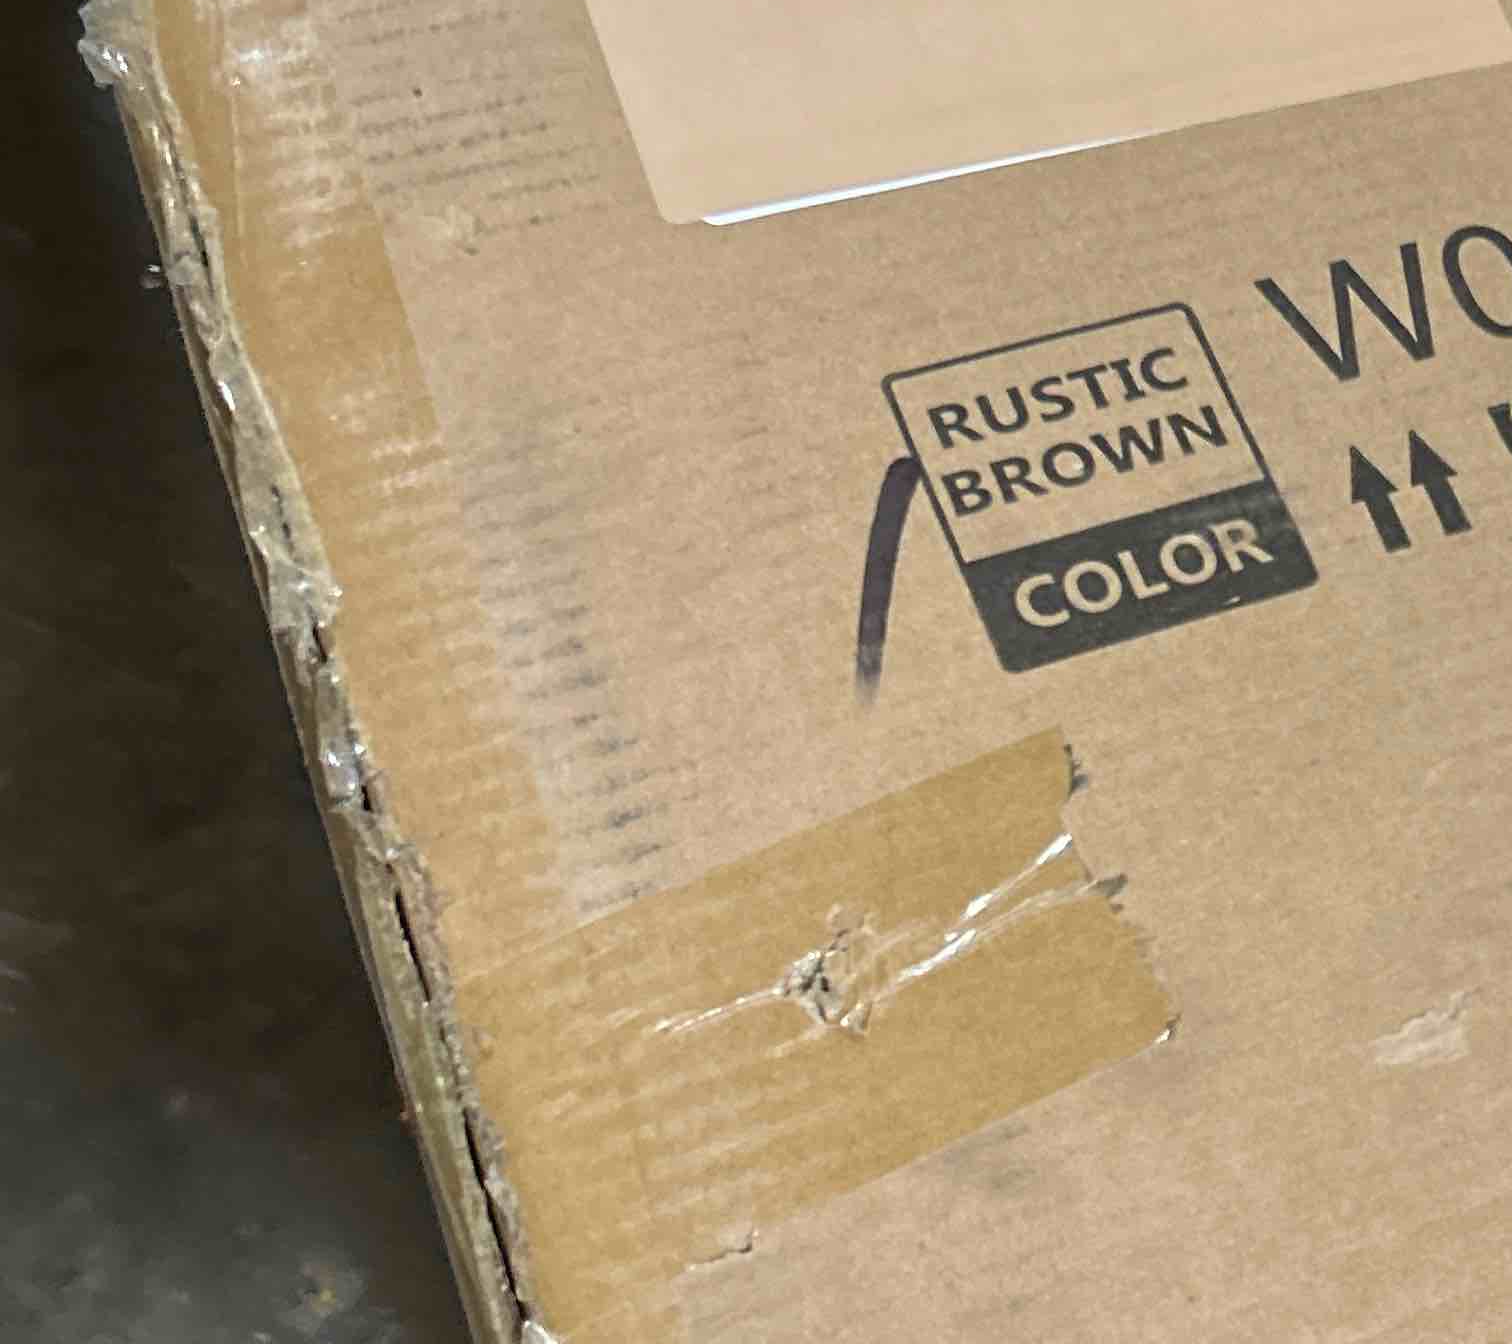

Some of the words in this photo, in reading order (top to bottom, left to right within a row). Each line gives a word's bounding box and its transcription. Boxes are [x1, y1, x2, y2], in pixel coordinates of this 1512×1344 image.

[927, 346, 1188, 449] RUSTIC
[940, 404, 1228, 518] BROWN
[1012, 516, 1274, 629] COLOR
